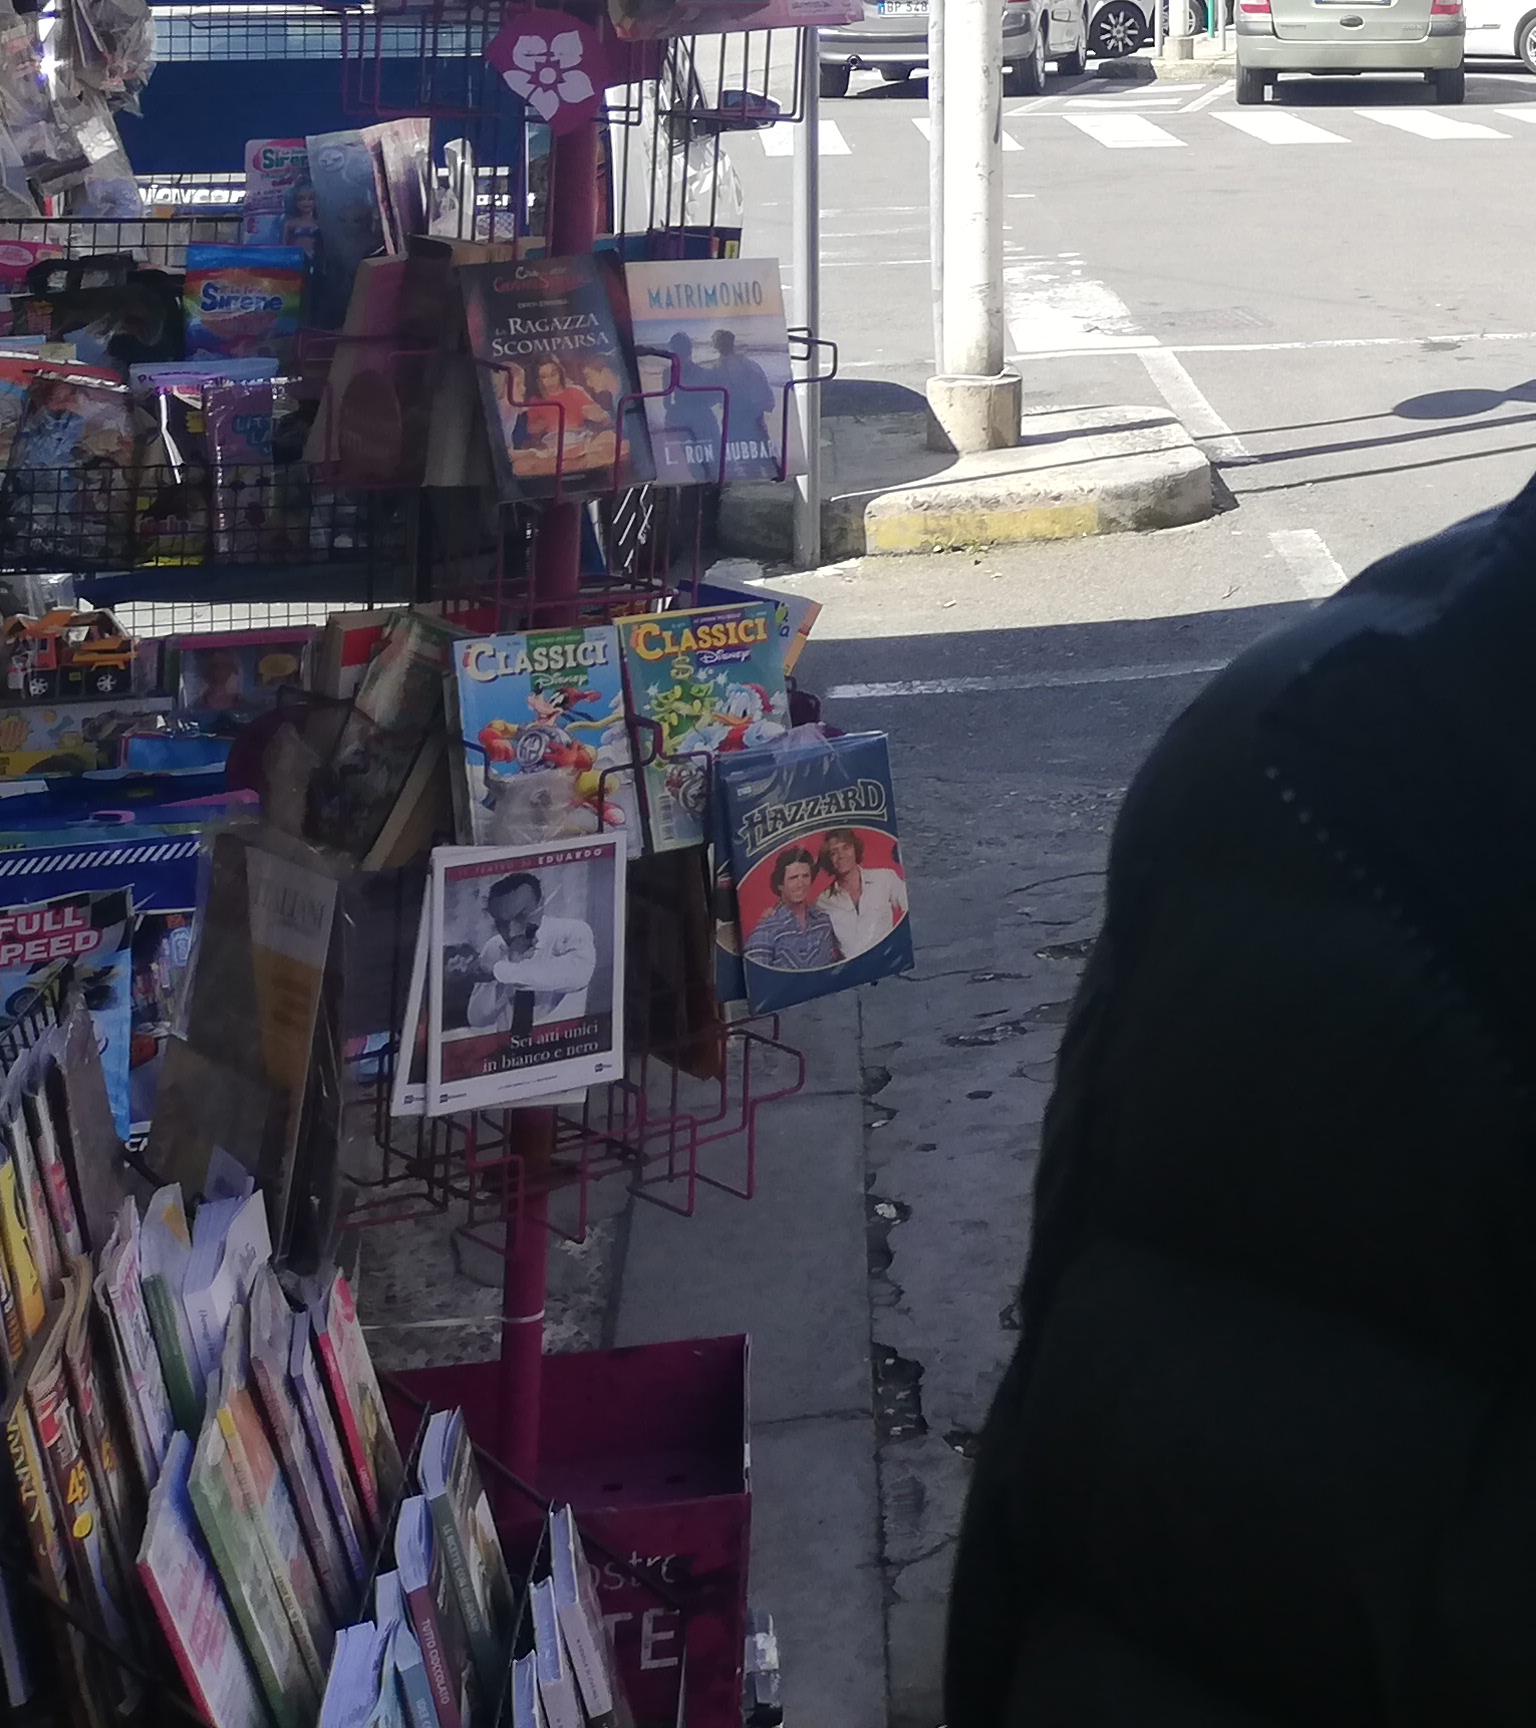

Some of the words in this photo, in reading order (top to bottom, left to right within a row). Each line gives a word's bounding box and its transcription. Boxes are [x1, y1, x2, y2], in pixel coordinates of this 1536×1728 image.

[648, 280, 763, 309] MATRIMONIO
[507, 313, 600, 336] RAGAZZA
[491, 332, 609, 357] SCOMPARSA
[685, 443, 714, 464] RON
[635, 617, 767, 660] CLASSICI
[467, 640, 607, 681] CLASSICI
[695, 648, 752, 664] Disney
[531, 672, 588, 689] Disney
[740, 779, 888, 857] HAZZARD
[537, 848, 602, 865] EDUARDO
[0, 930, 99, 965] PEED
[564, 1022, 599, 1041] unici
[483, 1058, 497, 1073] in
[502, 1050, 551, 1069] bianco
[554, 1050, 562, 1060] e
[566, 1041, 599, 1057] nero
[421, 1618, 436, 1649] TUTTO
